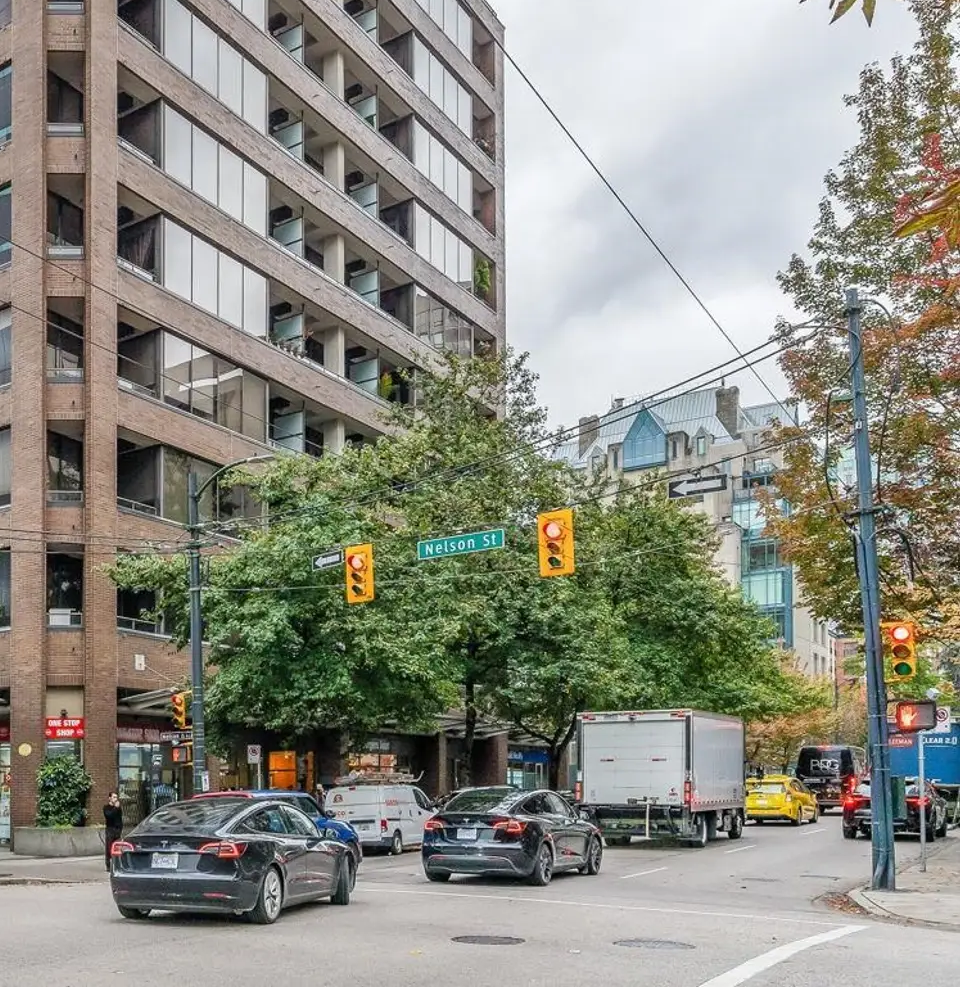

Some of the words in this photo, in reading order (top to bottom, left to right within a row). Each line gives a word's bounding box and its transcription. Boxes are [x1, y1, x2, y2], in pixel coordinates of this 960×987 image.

[425, 539, 475, 556] Nelson
[483, 533, 497, 547] St
[48, 719, 62, 727] ONE
[63, 719, 81, 727] STOP
[56, 728, 75, 737] SHOP
